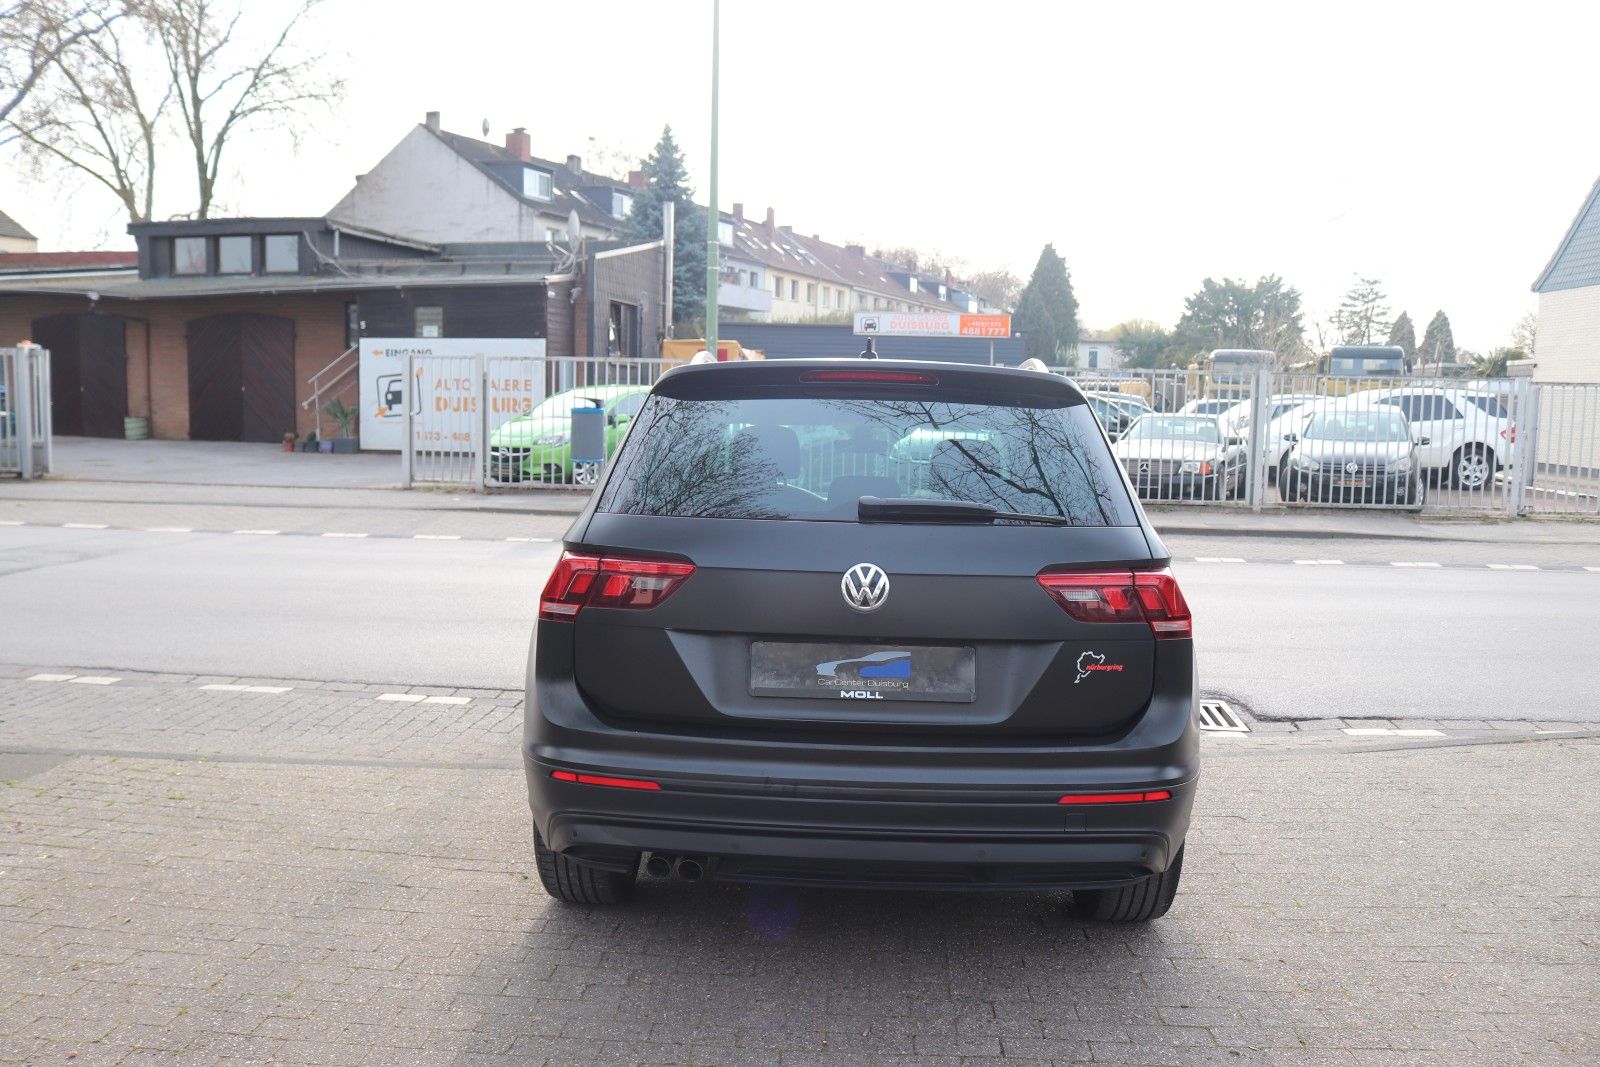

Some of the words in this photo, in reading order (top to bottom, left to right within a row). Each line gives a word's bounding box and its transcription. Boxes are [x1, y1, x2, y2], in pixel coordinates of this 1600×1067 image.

[889, 320, 950, 330] DUISBURG
[435, 395, 533, 414] DUISURG
[1086, 663, 1124, 672] nürburgring
[817, 678, 867, 687] CarCenter
[867, 679, 909, 689] Duisburg
[840, 690, 884, 699] MOLL
